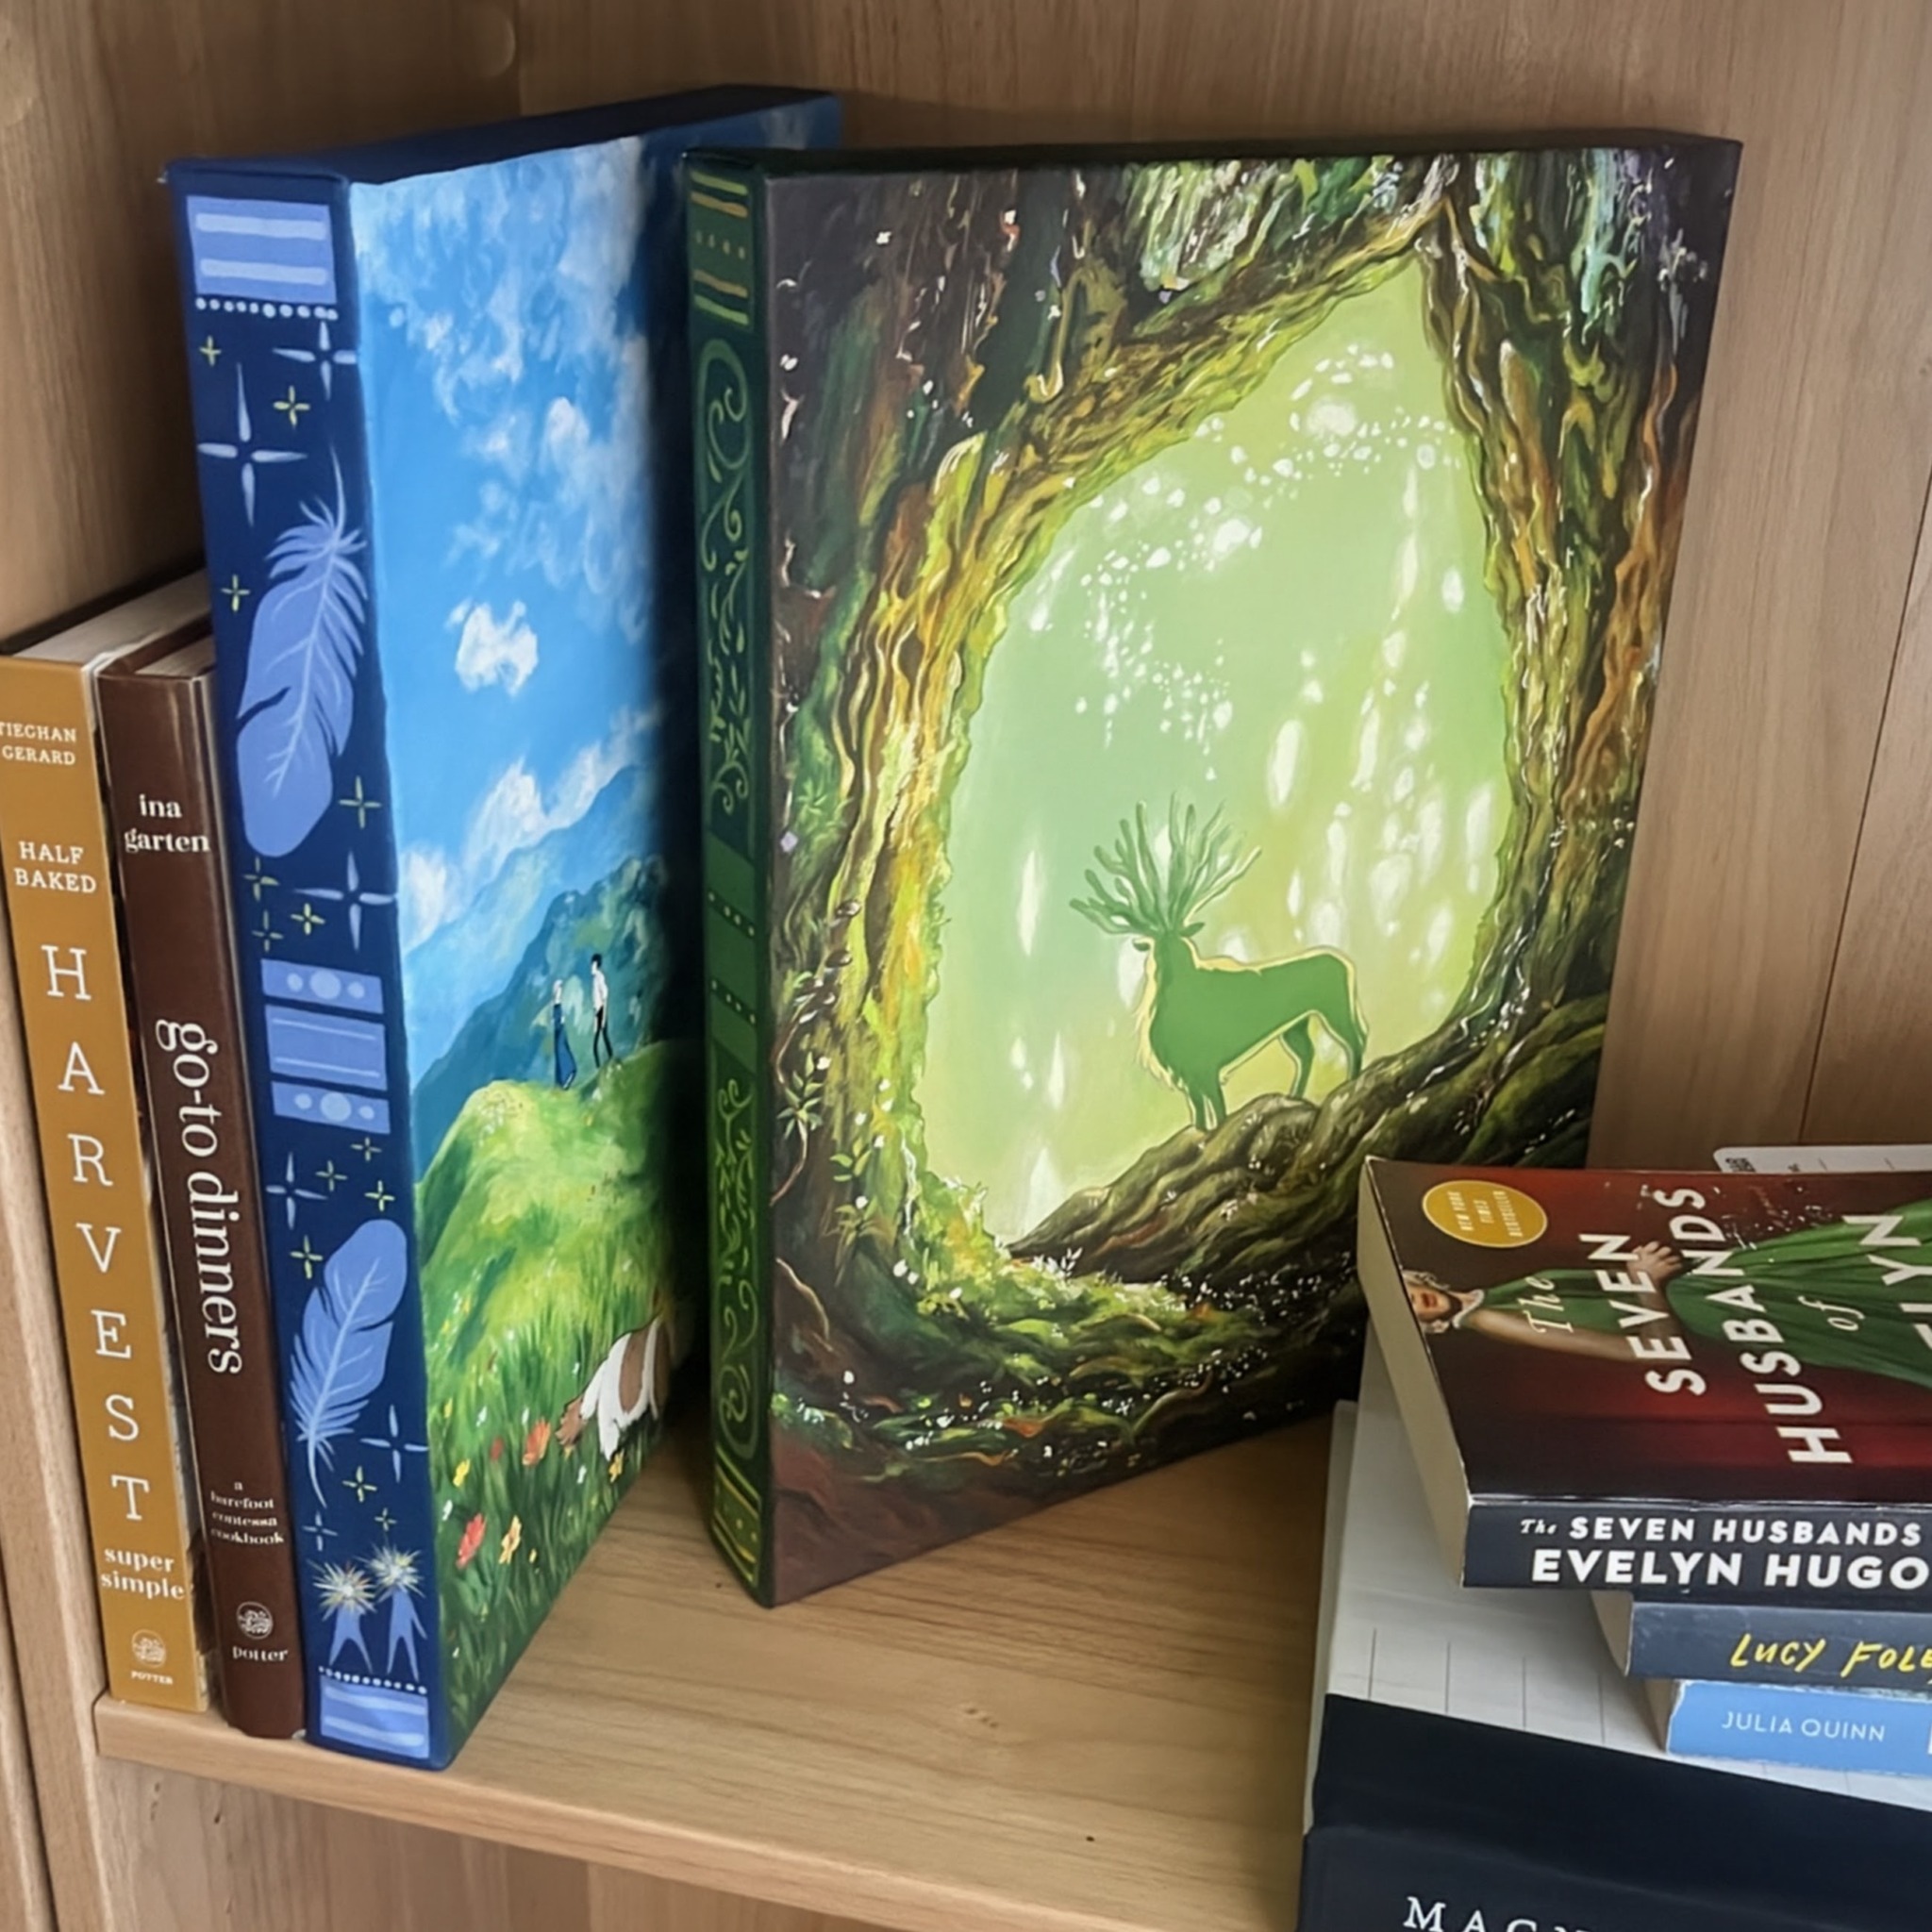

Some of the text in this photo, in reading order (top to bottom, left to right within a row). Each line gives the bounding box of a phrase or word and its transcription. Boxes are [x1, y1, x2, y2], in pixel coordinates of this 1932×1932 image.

[139, 793, 182, 819] ina
[18, 841, 84, 865] HALF
[124, 827, 210, 853] garten
[13, 867, 97, 894] BAKED
[156, 1018, 243, 1374] go-to dinners
[41, 944, 150, 1521] HARVEST
[1517, 1275, 1574, 1334] The
[1578, 1233, 1707, 1396] SEVEN
[1797, 1294, 1866, 1332] of
[1652, 1188, 1853, 1464] HUSBANDS
[1520, 1516, 1922, 1547] The SEVEN HUSBANDS
[104, 1547, 175, 1573] super
[1531, 1548, 1930, 1591] EVELYN HUGO
[100, 1570, 186, 1601] simple
[130, 1670, 174, 1686] POTTER
[1840, 1640, 1932, 1685] FOLE
[1721, 1711, 1886, 1742] JULIA QUINN
